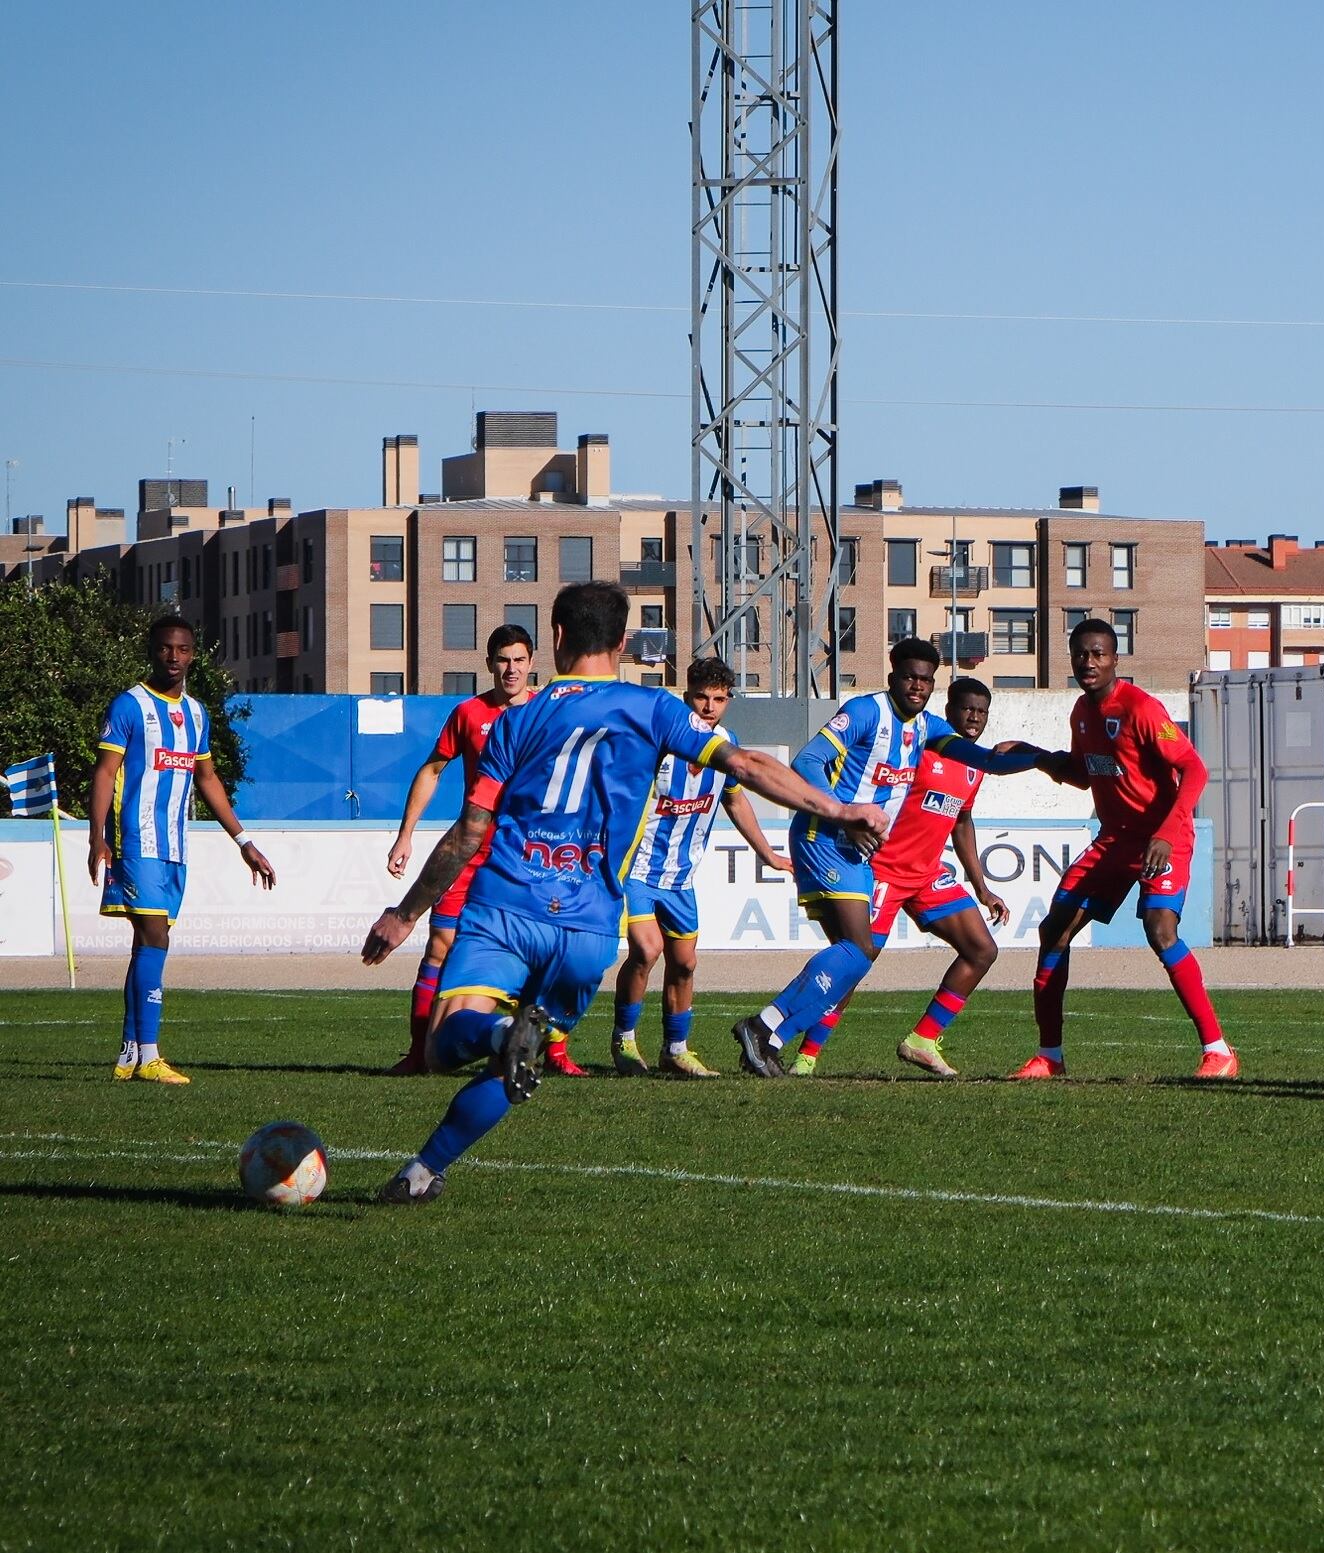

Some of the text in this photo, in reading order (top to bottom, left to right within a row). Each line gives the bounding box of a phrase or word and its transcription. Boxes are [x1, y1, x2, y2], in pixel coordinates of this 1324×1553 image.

[541, 726, 609, 814] 11
[661, 796, 711, 815] Pascual
[527, 828, 566, 841] odegas
[174, 935, 292, 947] PREFABRICADOS
[304, 935, 368, 947] FORJADO
